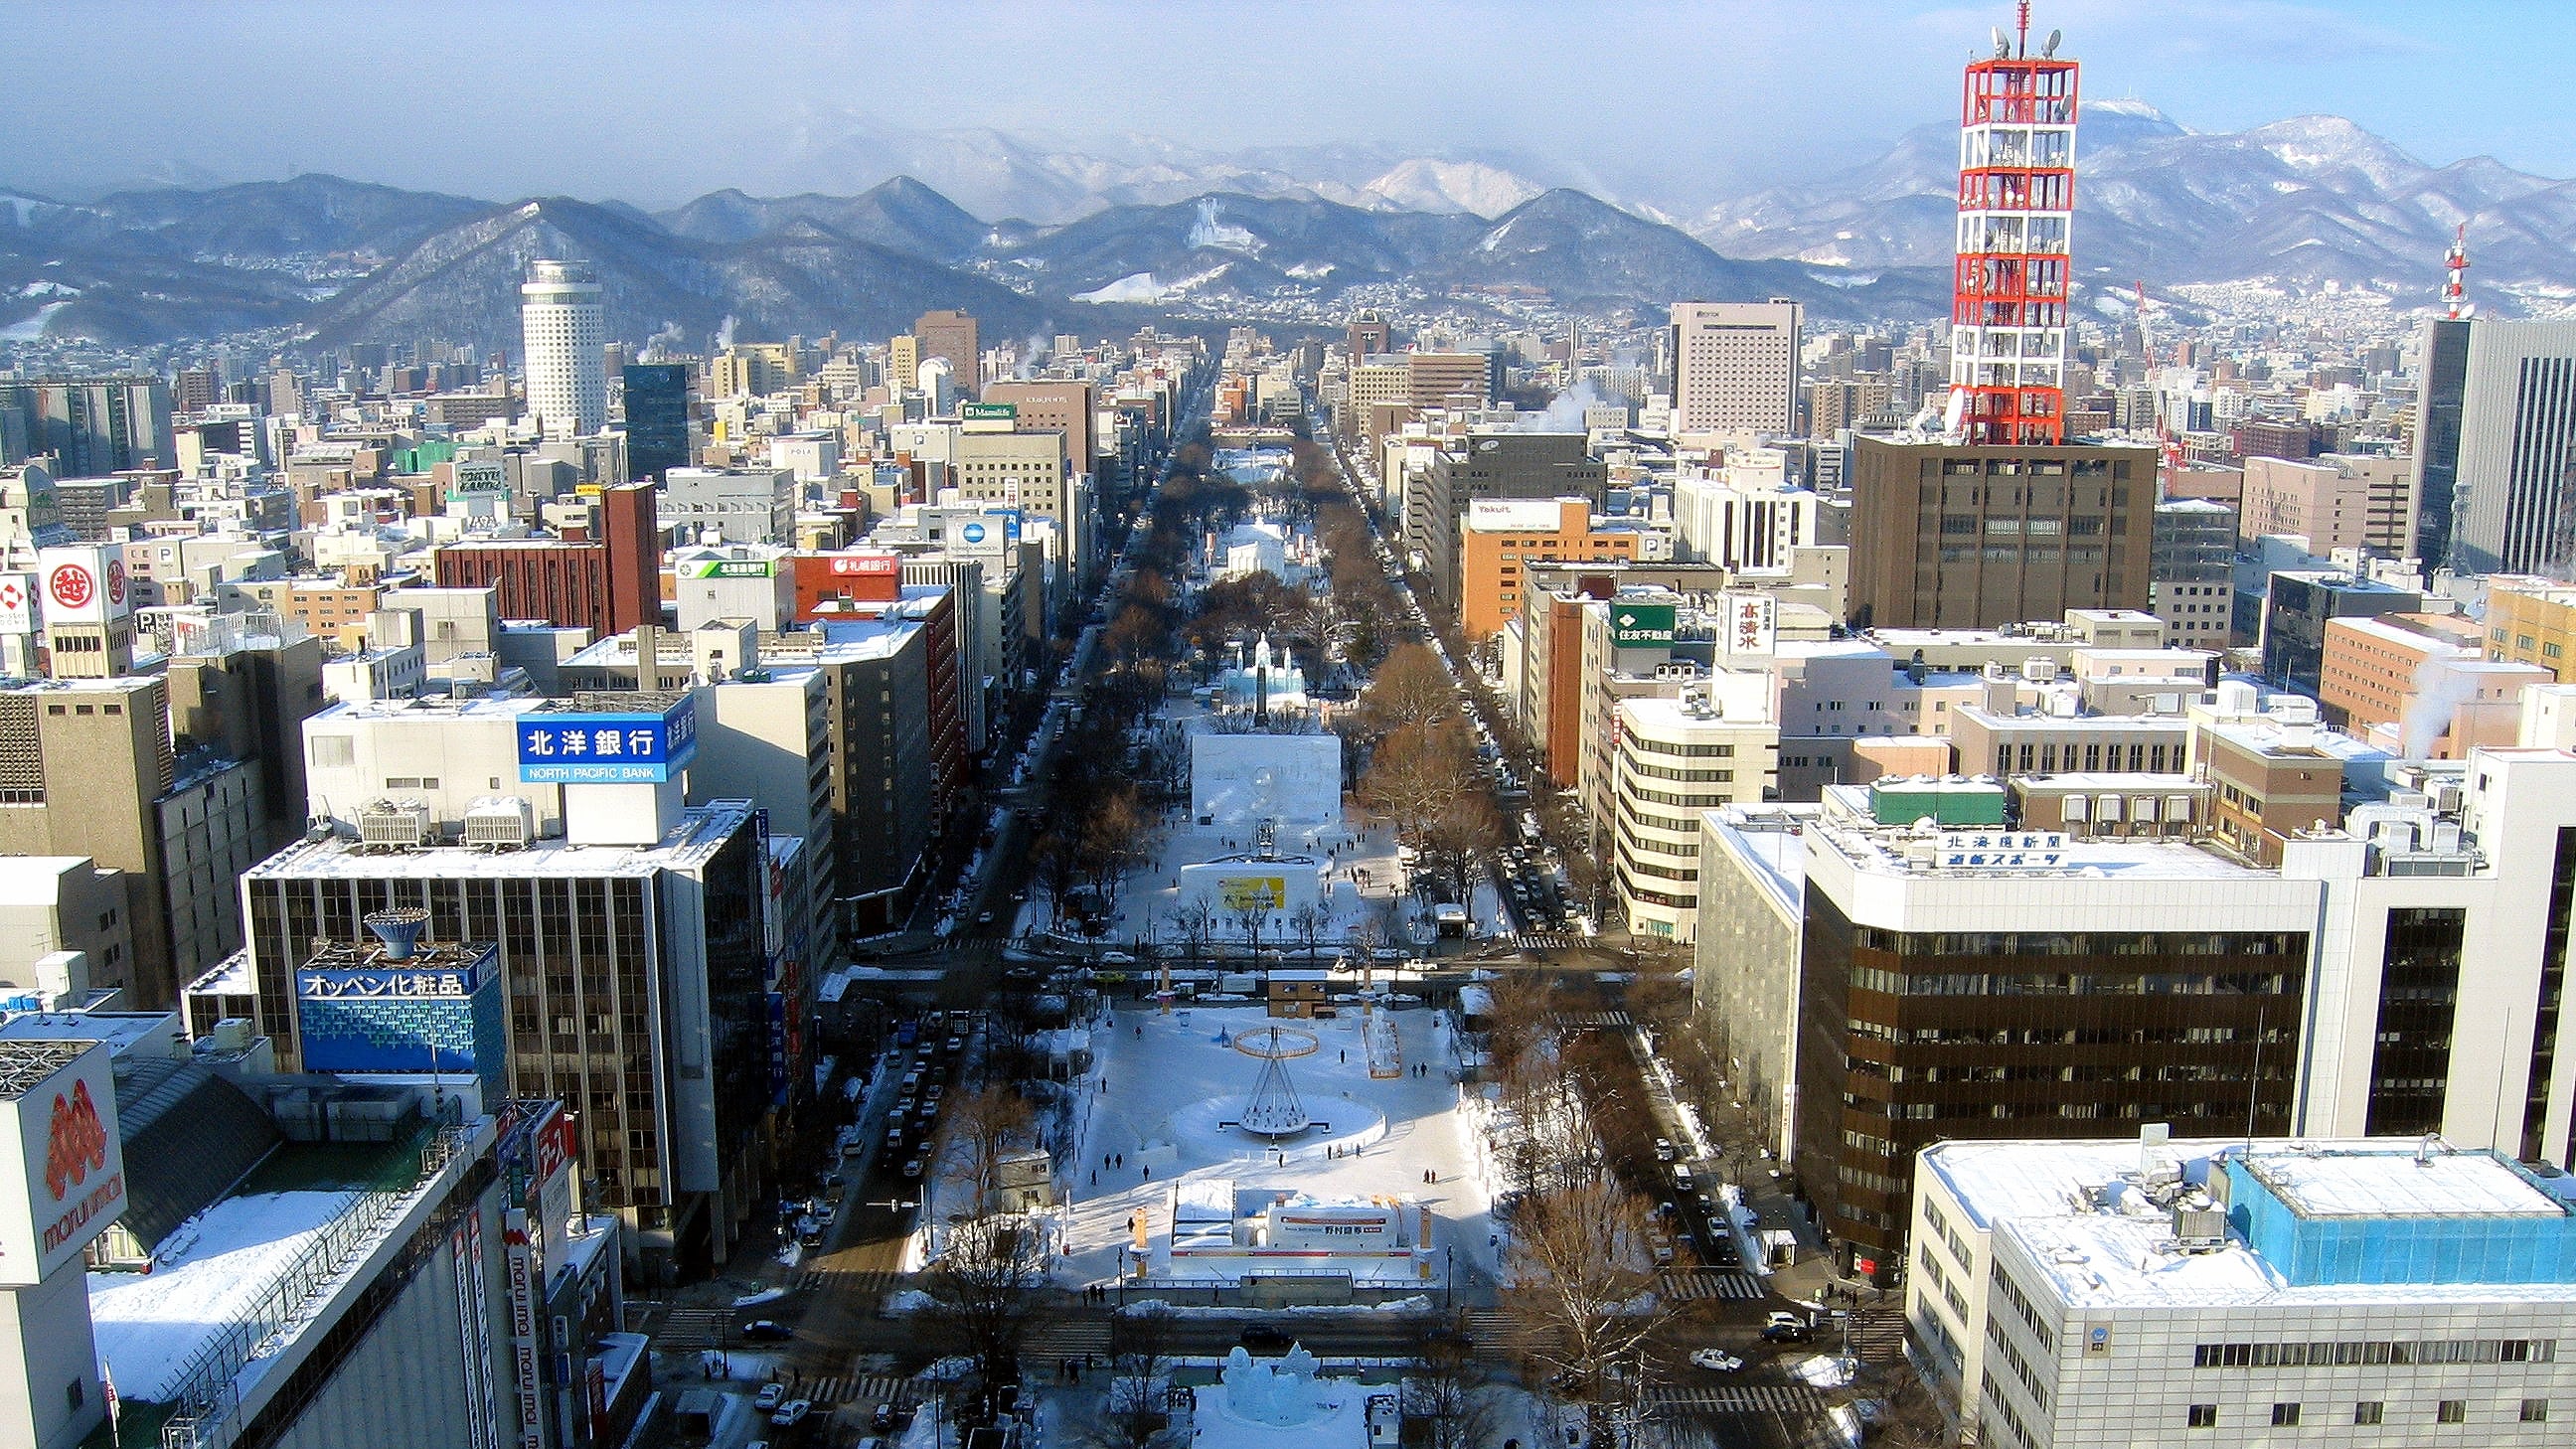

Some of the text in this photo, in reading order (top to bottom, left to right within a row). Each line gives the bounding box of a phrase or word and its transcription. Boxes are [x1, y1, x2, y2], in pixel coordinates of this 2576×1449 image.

[161, 550, 171, 561] P
[850, 560, 891, 571] 札幌銀行
[1619, 629, 1674, 641] 住友不動産
[527, 729, 654, 756] 北洋銀行
[529, 767, 655, 779] NORTH PACIFIC BANK
[1947, 835, 2061, 849] 北海道新聞
[1947, 852, 2061, 866] 道新スポーツ
[303, 974, 464, 996] オッペン化粧品
